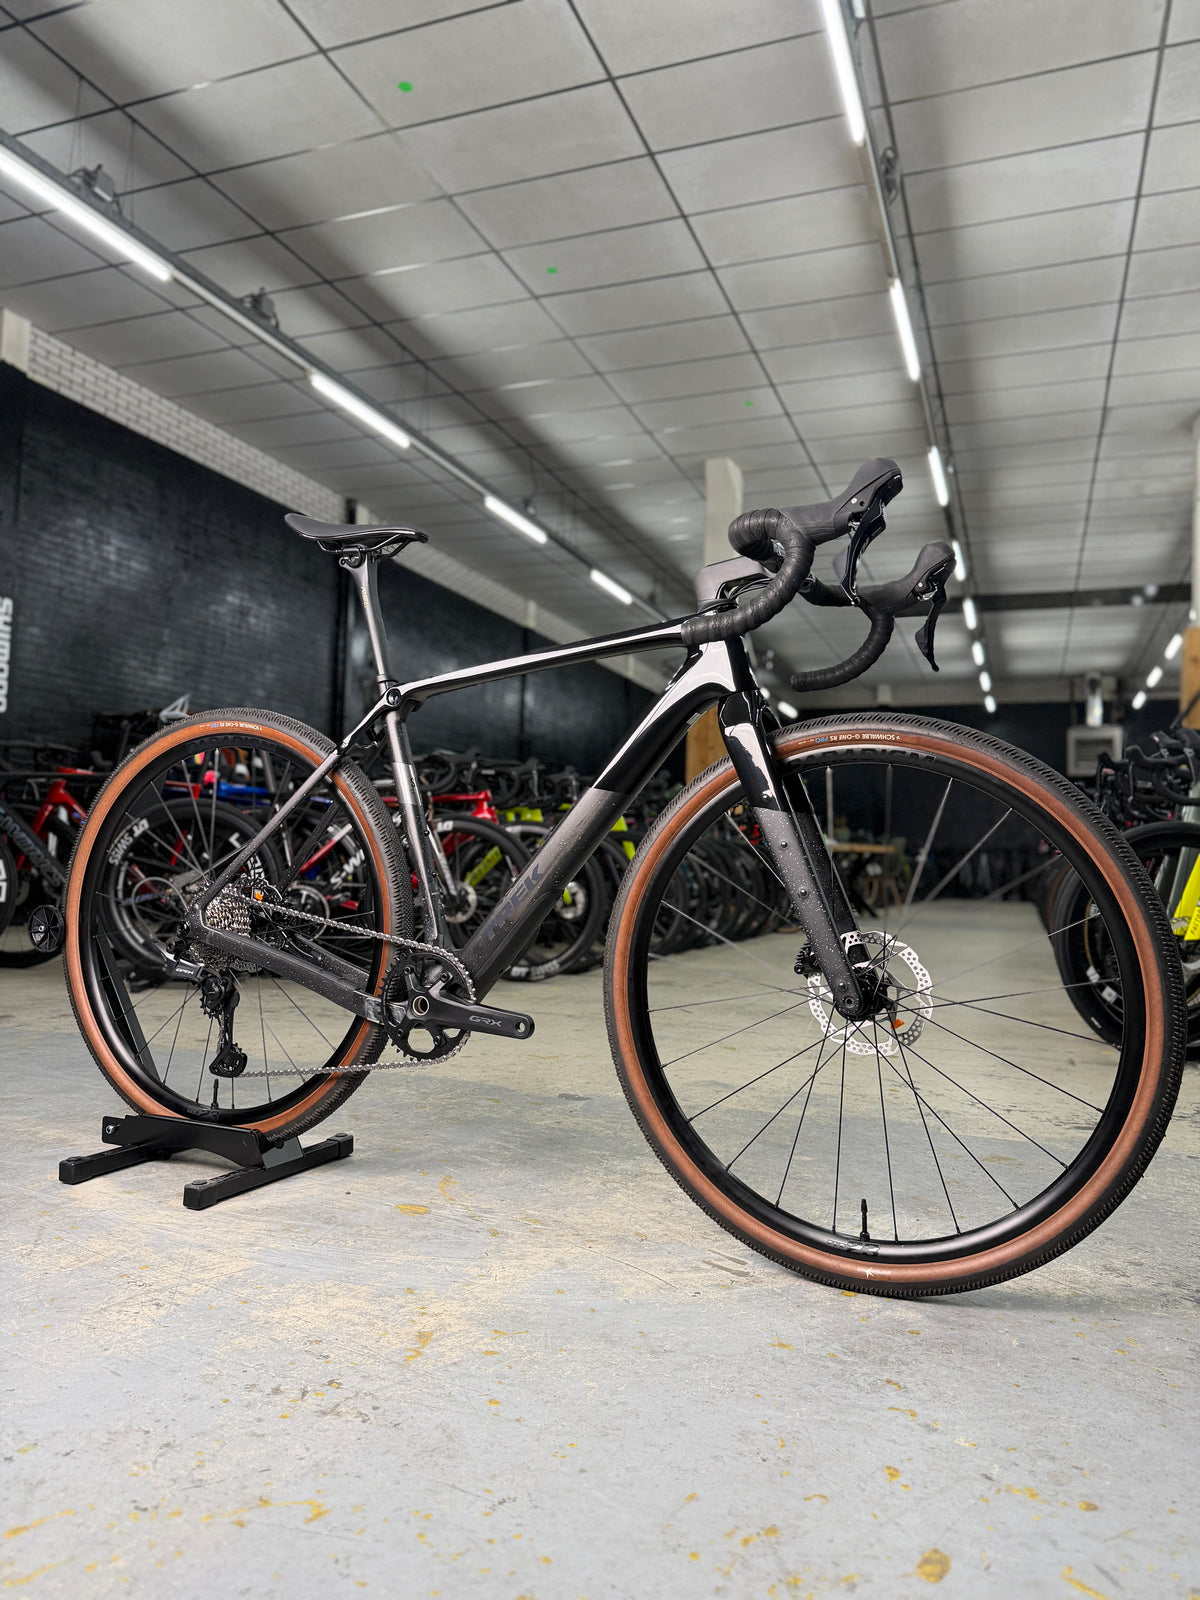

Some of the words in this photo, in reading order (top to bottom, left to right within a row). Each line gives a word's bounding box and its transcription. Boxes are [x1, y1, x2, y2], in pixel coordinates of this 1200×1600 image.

[814, 736, 829, 744] PRO
[861, 733, 895, 741] SCHWALBE
[108, 832, 133, 866] SWISS
[481, 862, 546, 941] TREK
[469, 1015, 502, 1027] GRX
